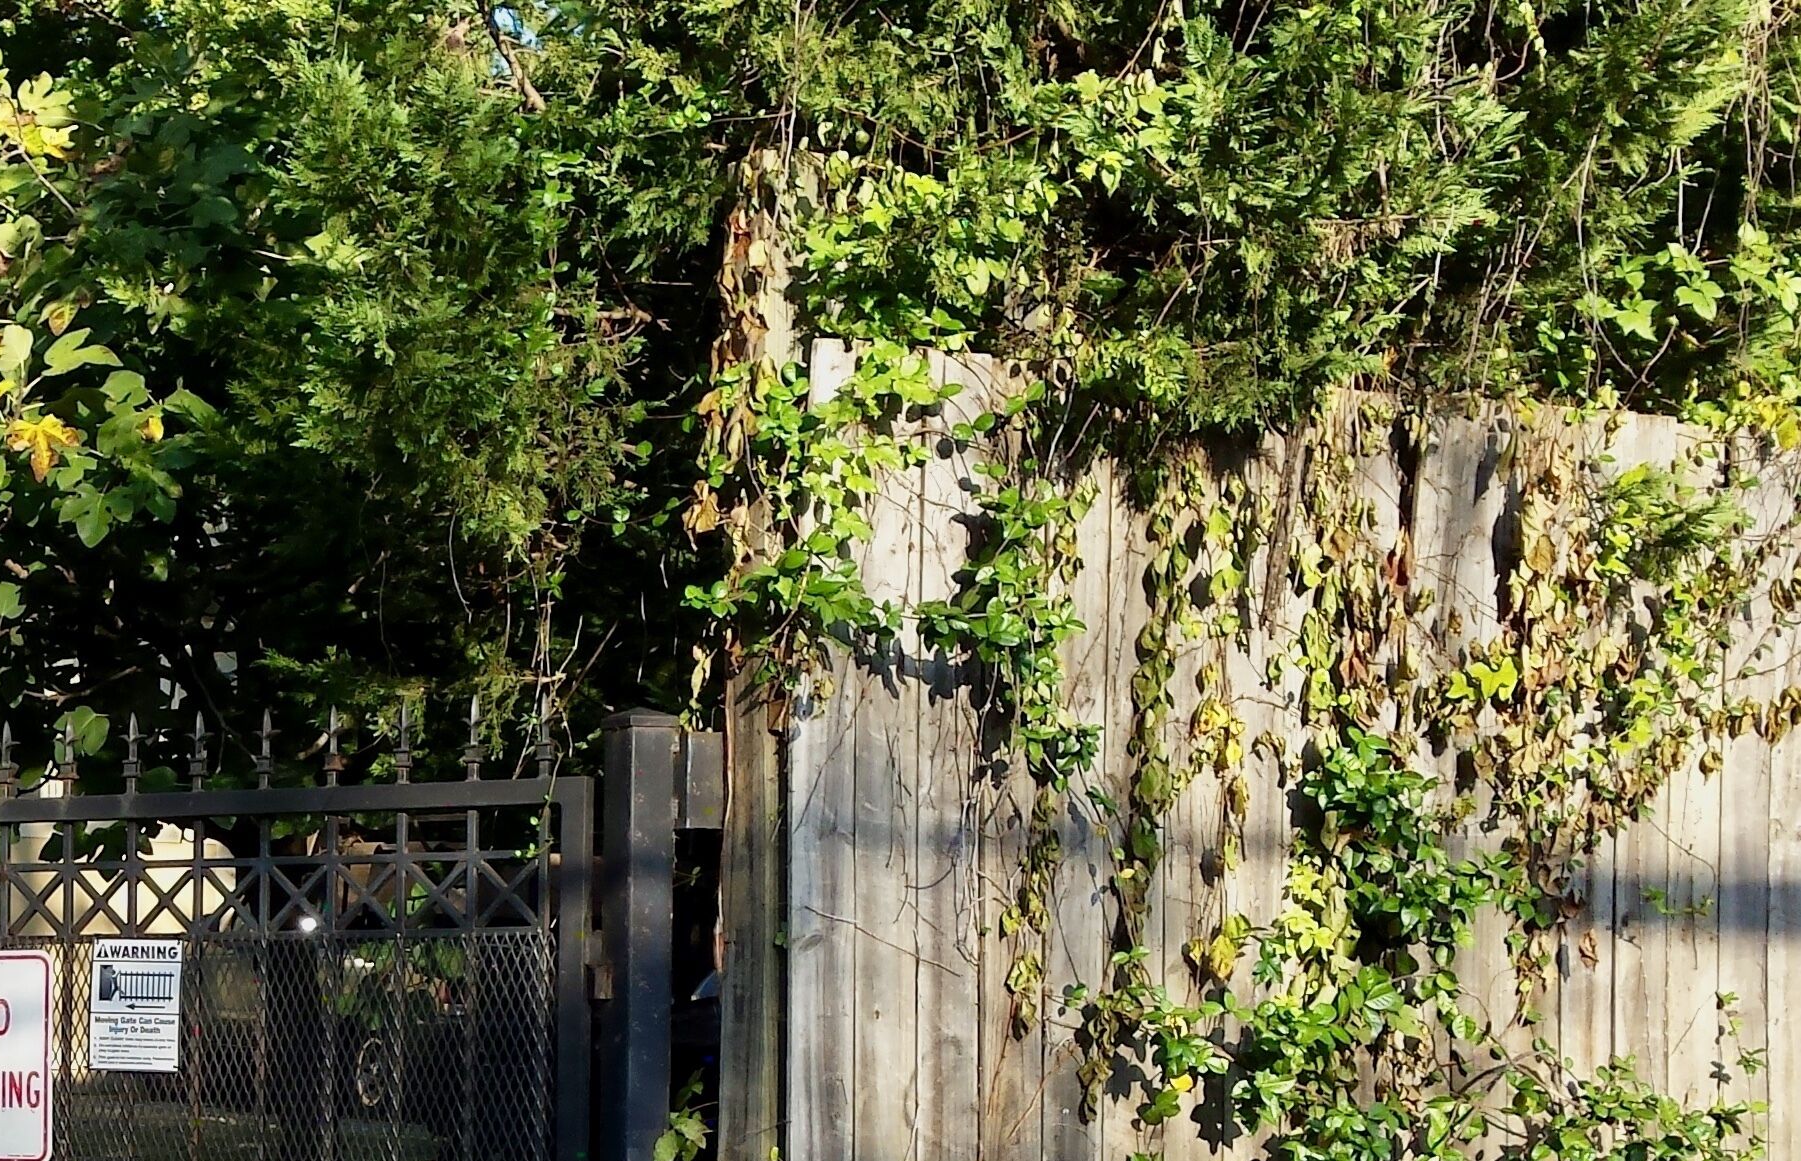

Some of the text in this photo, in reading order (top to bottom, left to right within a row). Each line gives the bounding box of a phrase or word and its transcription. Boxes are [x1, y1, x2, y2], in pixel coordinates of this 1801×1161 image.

[109, 946, 178, 959] WARNING
[94, 1016, 176, 1025] Moving Gate Can Cause
[108, 1025, 129, 1034] Injury
[140, 1026, 161, 1034] Death
